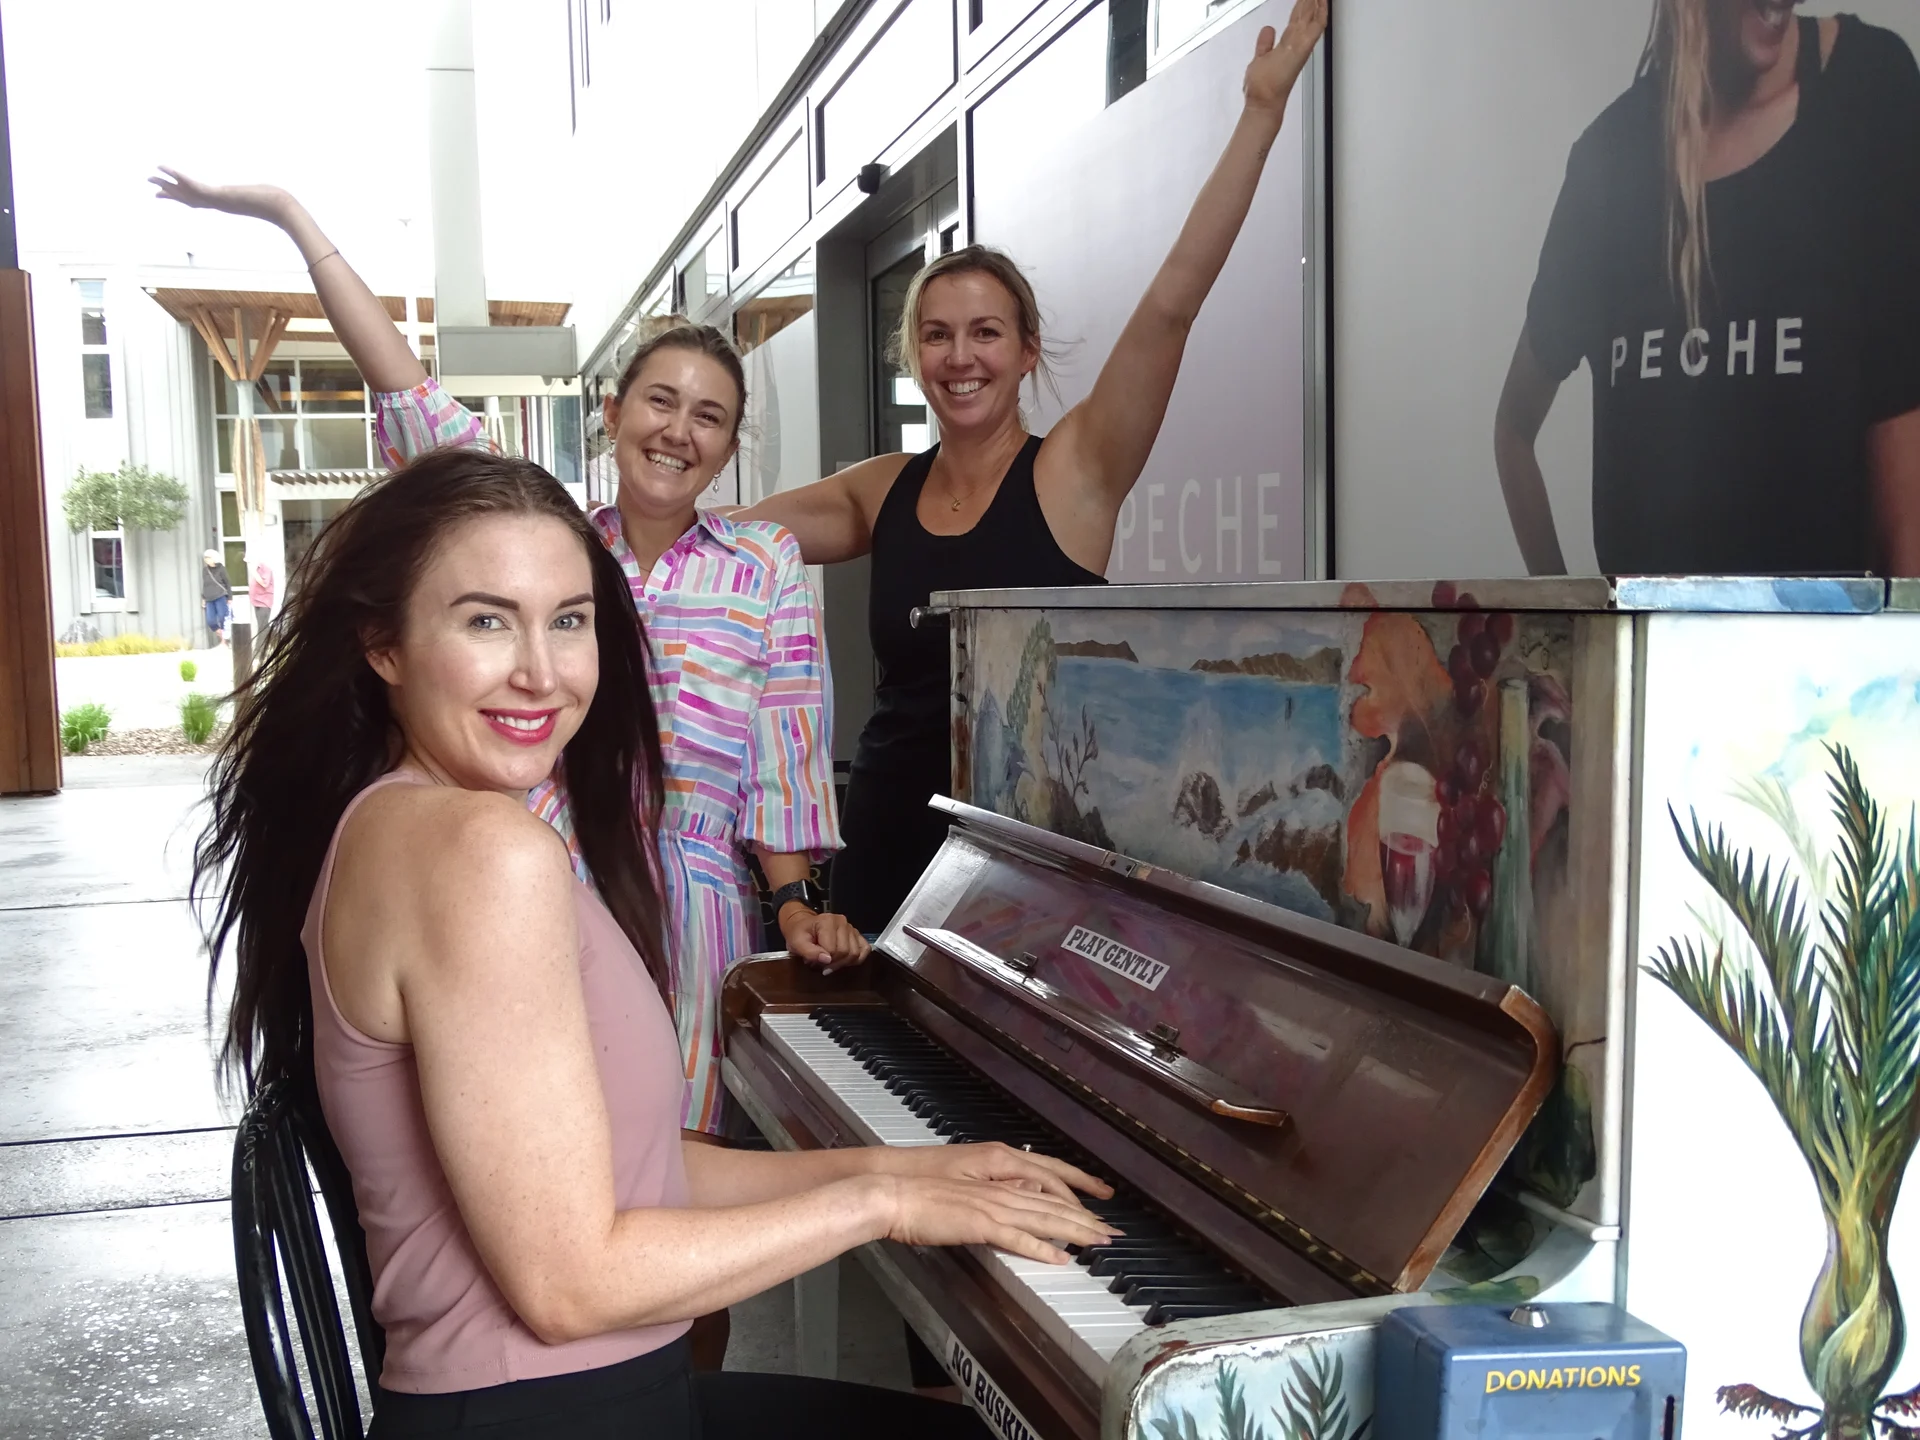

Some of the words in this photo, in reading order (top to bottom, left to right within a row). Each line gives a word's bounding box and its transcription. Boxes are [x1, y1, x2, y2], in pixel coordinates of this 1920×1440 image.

[1611, 317, 1804, 388] PECHE
[1118, 472, 1282, 575] PECHE
[1067, 928, 1109, 958] PLAY
[1102, 943, 1165, 985] GENTLY
[951, 1340, 974, 1388] NO
[1485, 1364, 1641, 1394] DONATIONS
